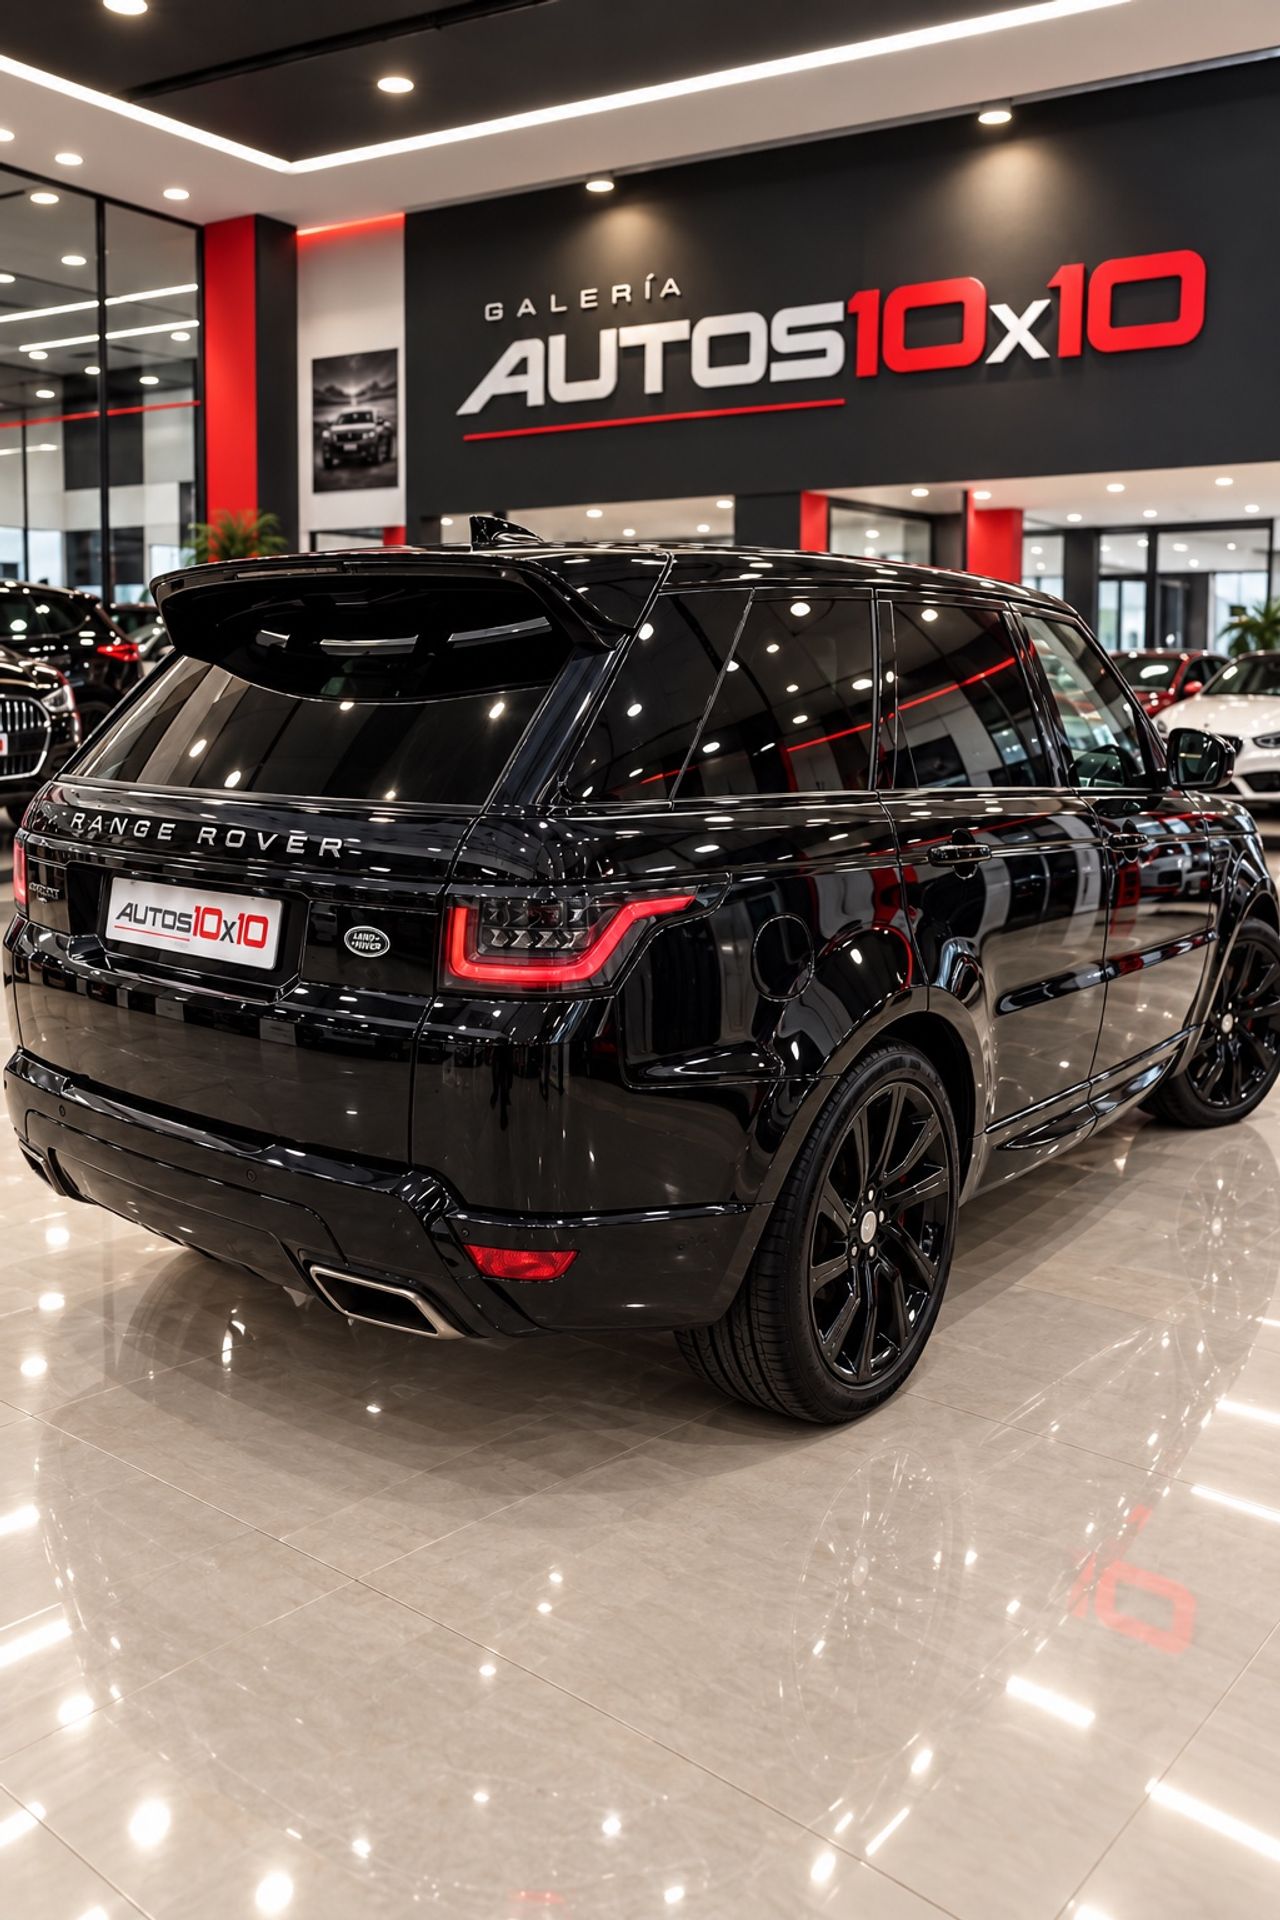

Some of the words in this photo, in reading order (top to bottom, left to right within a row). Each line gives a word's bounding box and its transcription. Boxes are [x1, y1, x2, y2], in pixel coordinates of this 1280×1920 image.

[484, 272, 681, 321] GALERÍA
[456, 249, 1207, 416] AUTOS10x10
[70, 812, 176, 841] RANGE
[196, 826, 343, 858] ROVER
[115, 902, 269, 949] AUTOS10x10
